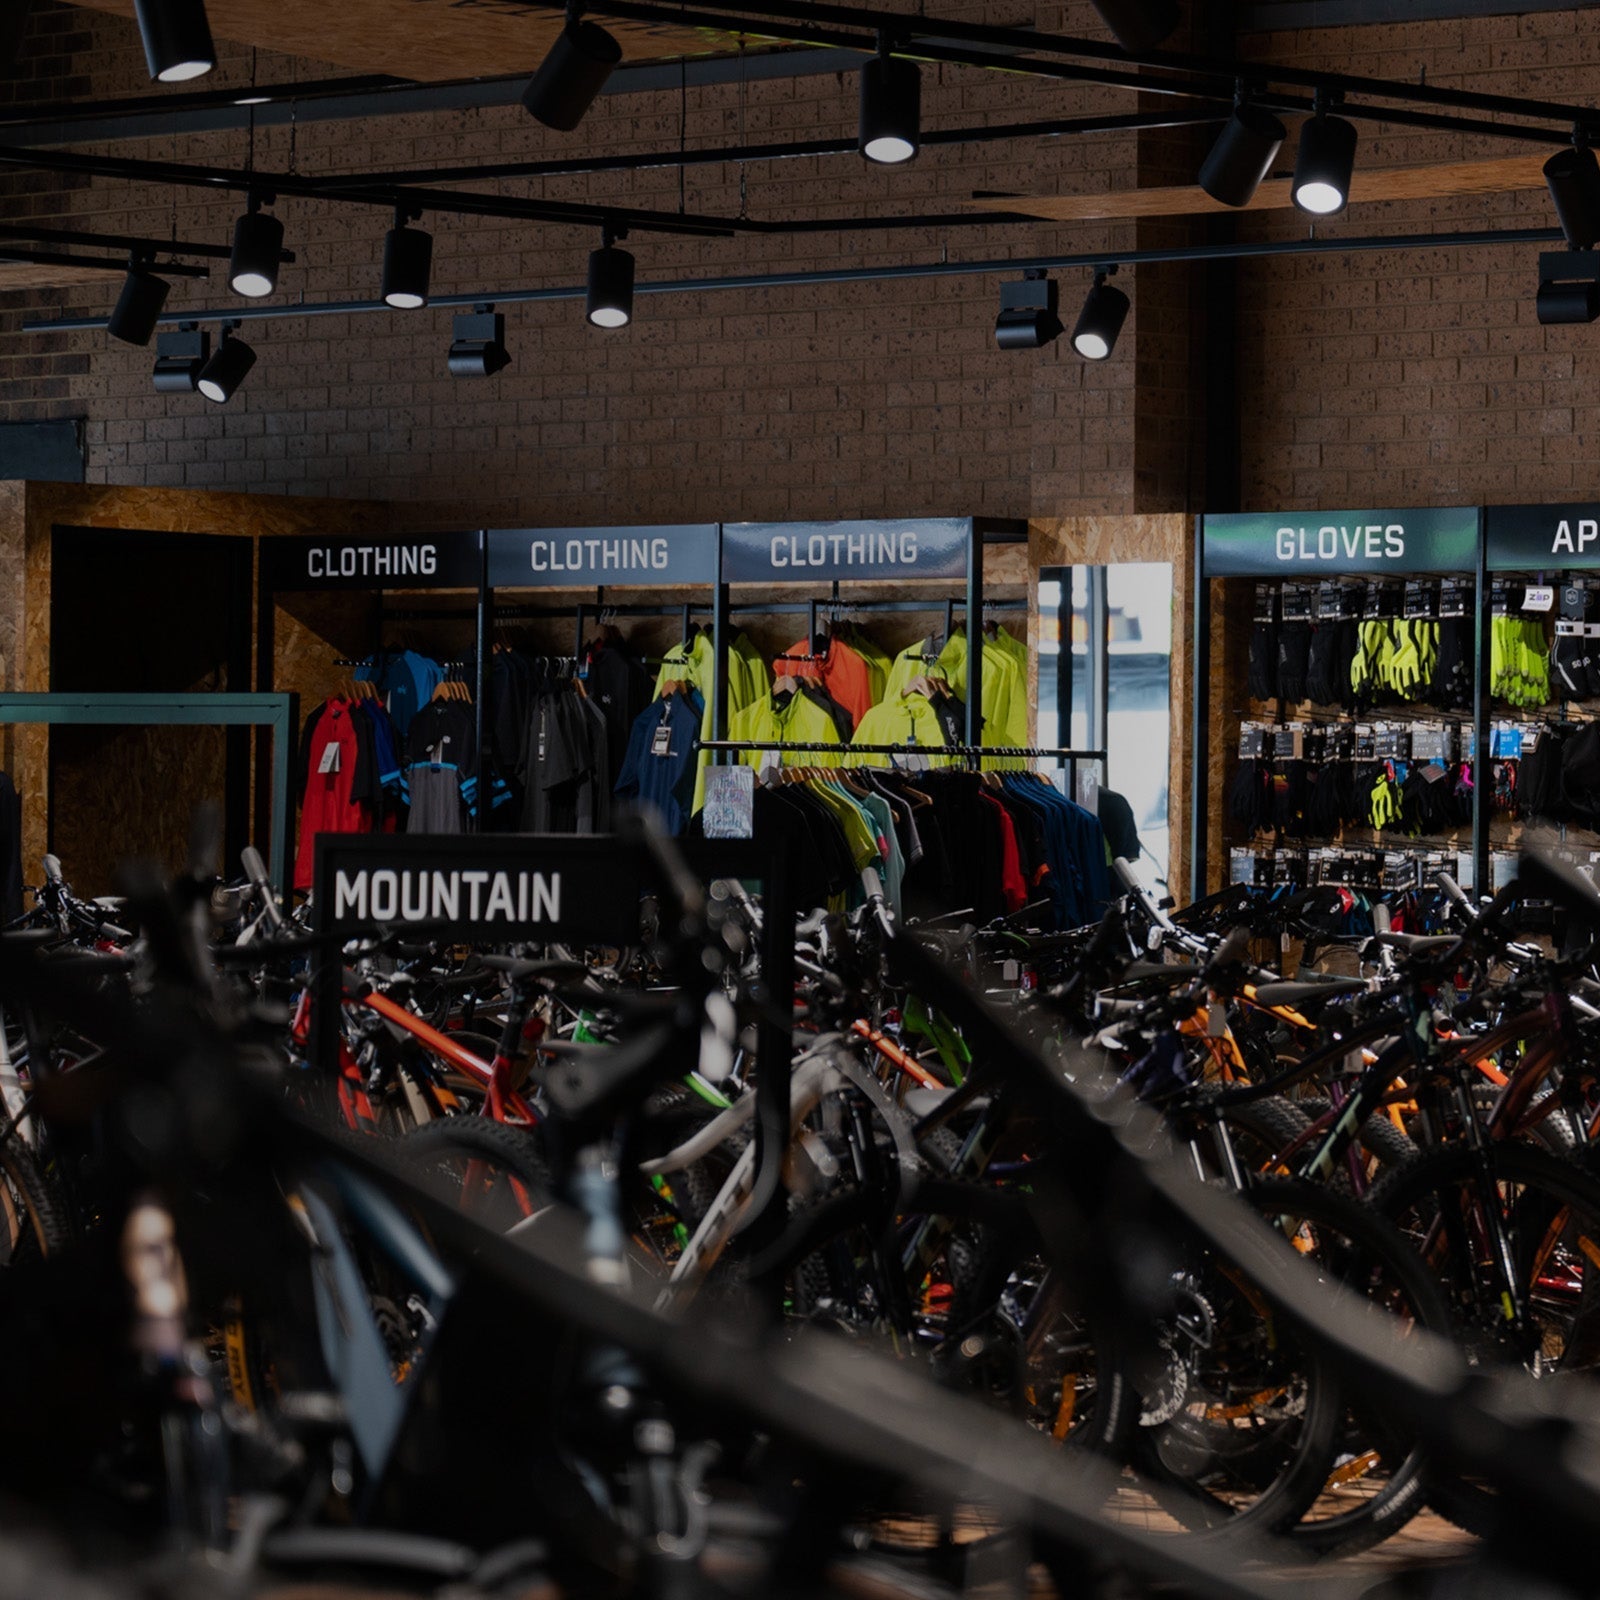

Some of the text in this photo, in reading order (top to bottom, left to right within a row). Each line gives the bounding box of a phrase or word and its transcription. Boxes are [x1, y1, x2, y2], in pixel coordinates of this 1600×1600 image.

[308, 544, 437, 578] CLOTHING
[531, 538, 669, 571] CLOTHING
[771, 530, 918, 567] CLOTHING
[1275, 524, 1405, 561] GLOVES
[335, 870, 560, 923] MOUNTAIN
